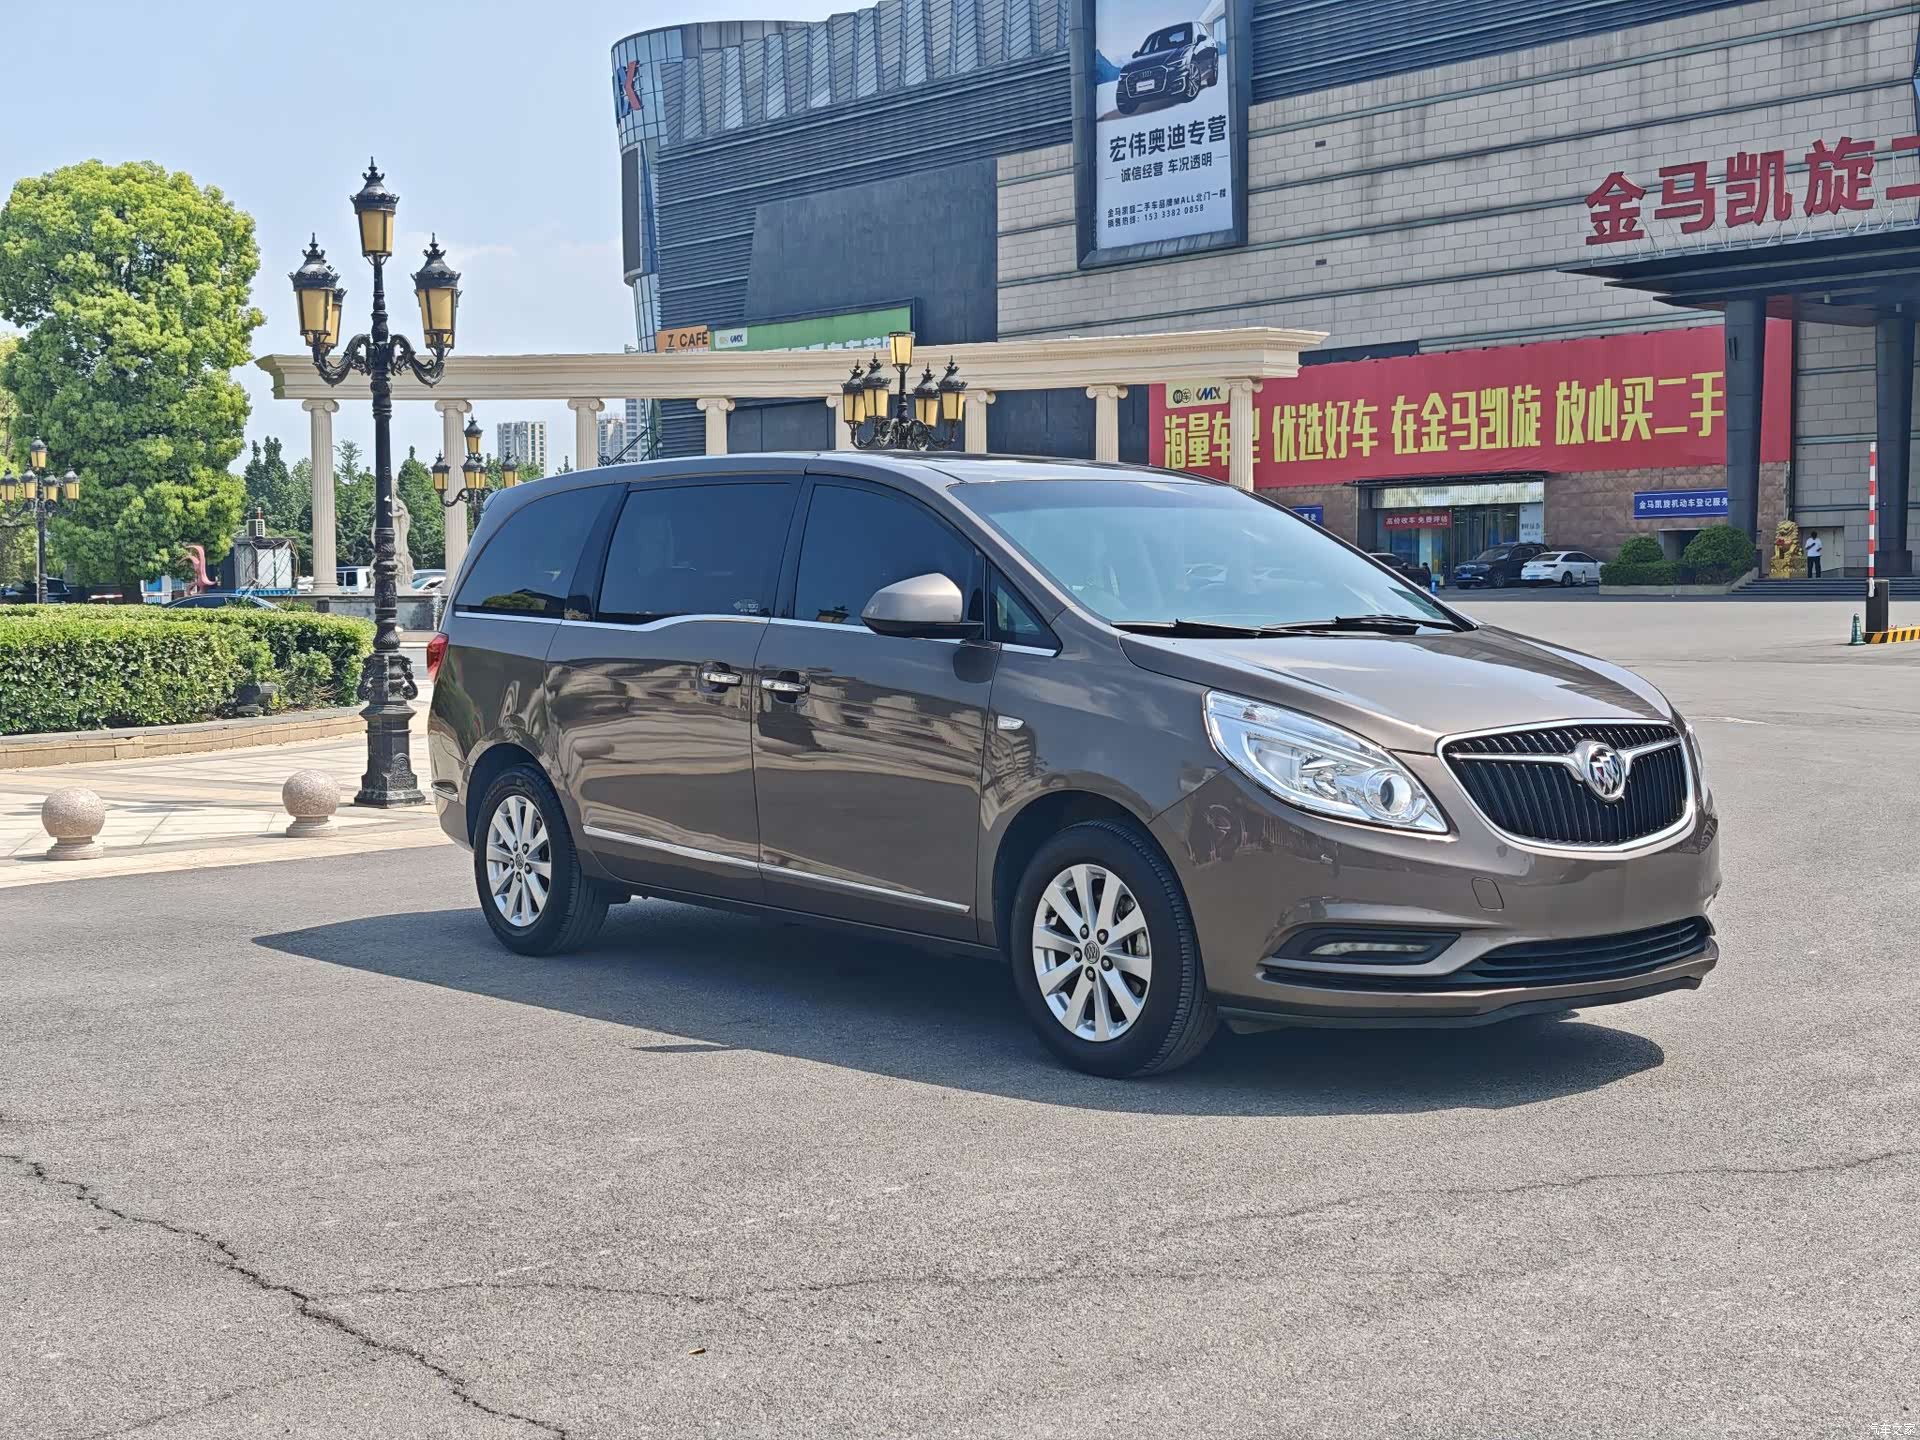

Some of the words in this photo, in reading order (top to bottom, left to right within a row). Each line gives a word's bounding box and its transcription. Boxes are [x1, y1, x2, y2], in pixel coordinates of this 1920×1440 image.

[1109, 115, 1227, 163] 宏伟奥迪专营
[1120, 161, 1164, 183] 诚信经营
[1168, 152, 1213, 174] 车况透明
[1144, 213, 1158, 222] 153
[1161, 208, 1181, 219] 3382
[1184, 204, 1204, 215] 0858
[679, 331, 708, 347] CAFE
[1164, 407, 1260, 469] 海量车
[1272, 399, 1378, 463] 优选好车
[1391, 384, 1541, 454] 在金马凯旋
[1555, 371, 1725, 445] 放心买二手
[1639, 497, 1728, 510] 金马凯旋机动车登记服务
